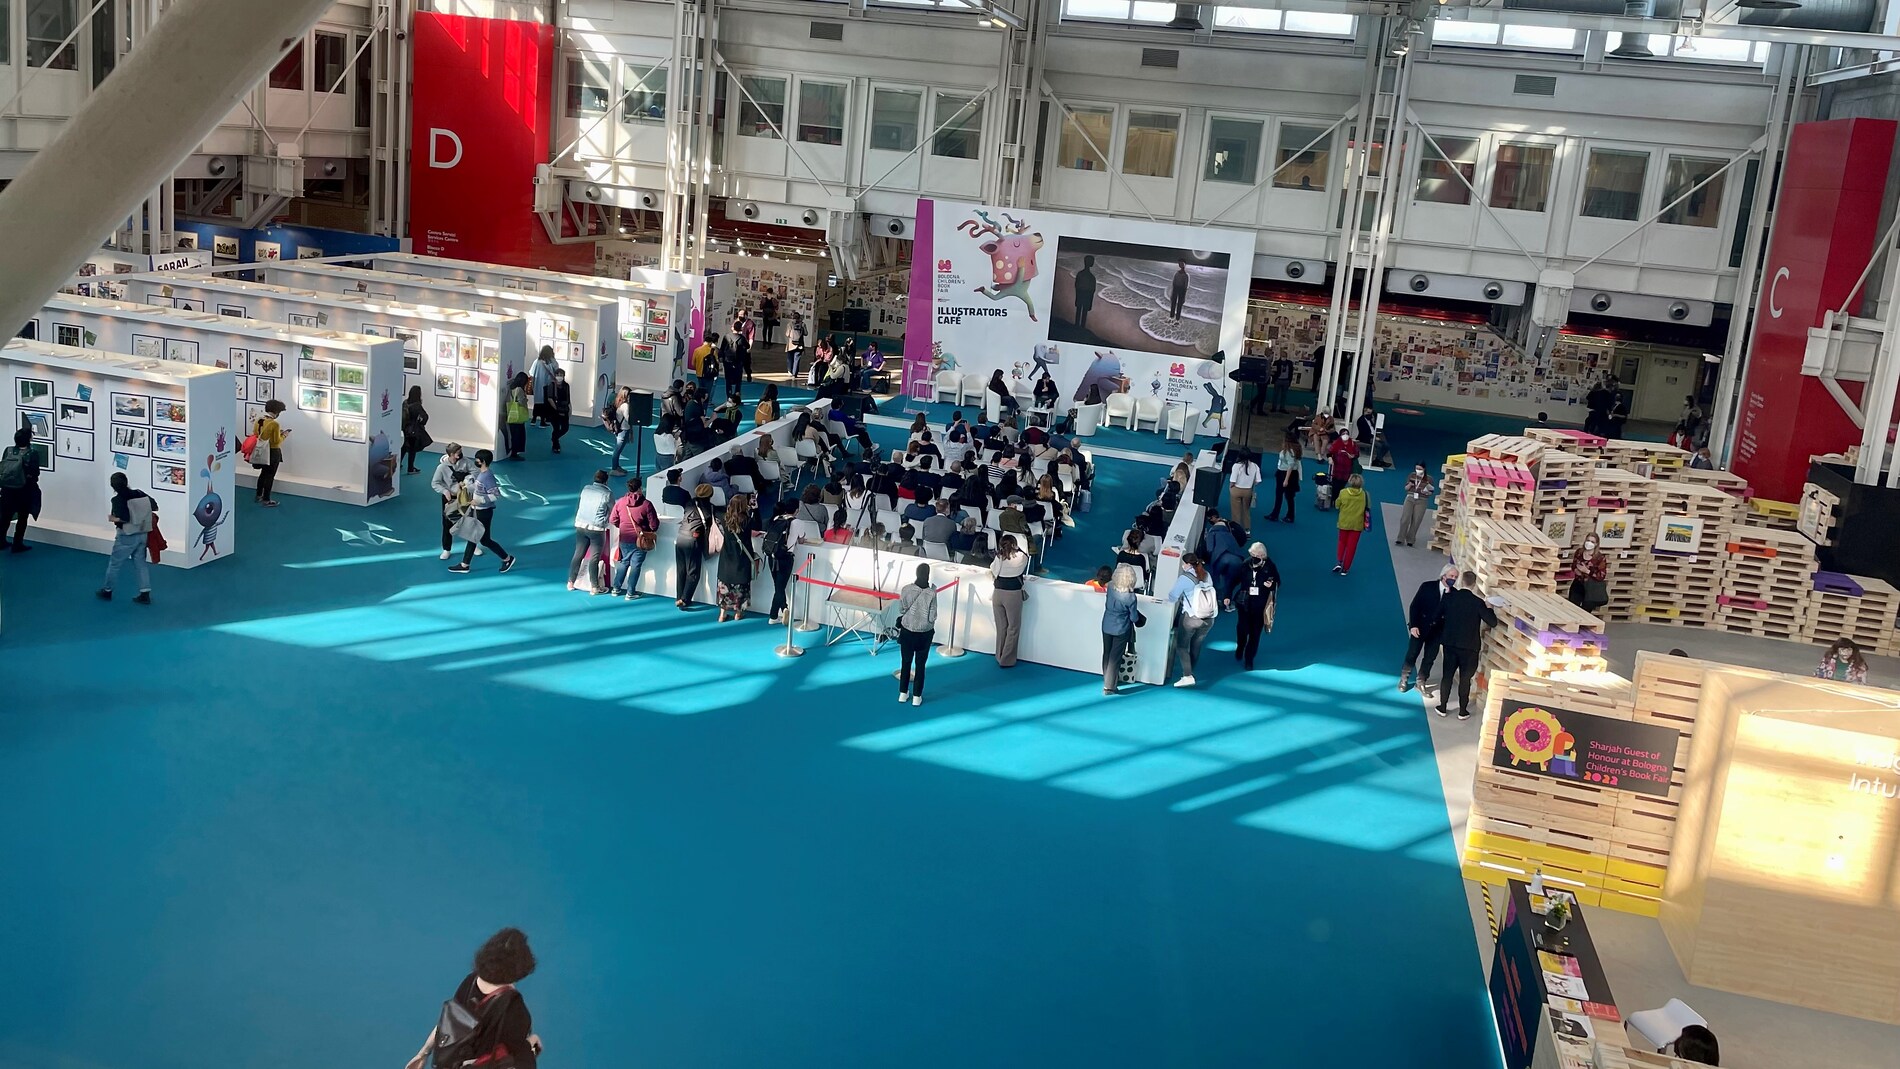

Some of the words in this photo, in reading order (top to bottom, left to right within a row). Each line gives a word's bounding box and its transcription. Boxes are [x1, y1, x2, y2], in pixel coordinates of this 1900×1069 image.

[430, 127, 463, 169] D
[157, 257, 189, 271] SARAH
[1770, 266, 1790, 319] C
[937, 306, 1008, 317] ILLUSTRATORS
[937, 313, 961, 325] CAFÉ
[1168, 377, 1193, 385] BOLOGNA
[1589, 740, 1621, 753] Sharjah
[1623, 747, 1649, 758] Guest
[1650, 752, 1661, 760] of
[1586, 761, 1628, 776] Children's
[1628, 769, 1651, 781] Book
[1652, 773, 1670, 783] Fair
[1587, 751, 1620, 764] Honour
[1621, 758, 1630, 766] at
[1632, 759, 1668, 773] Bologna
[1583, 770, 1618, 786] 2022
[1849, 772, 1900, 799] Intu
